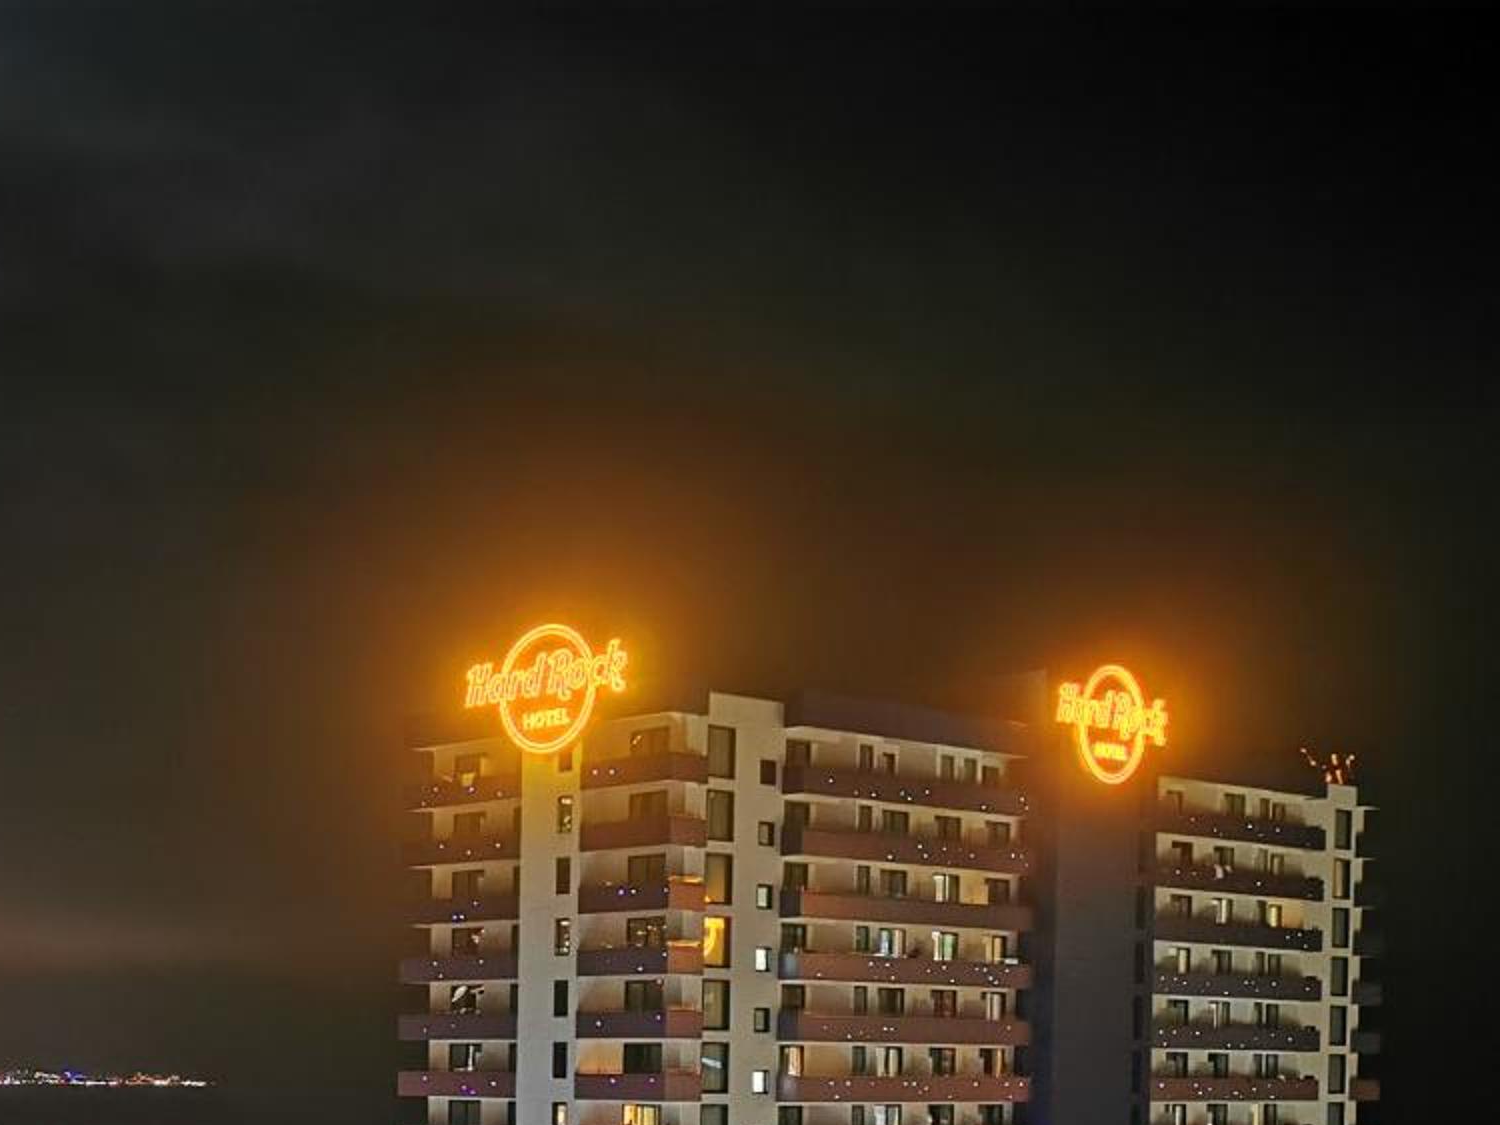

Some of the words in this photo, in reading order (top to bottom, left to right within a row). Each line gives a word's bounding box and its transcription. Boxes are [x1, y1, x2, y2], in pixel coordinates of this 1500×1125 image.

[465, 651, 548, 708] Hard
[546, 637, 628, 701] Rock
[523, 708, 570, 730] HOTEL
[1056, 683, 1116, 728] Hard
[1111, 691, 1168, 746] Rock
